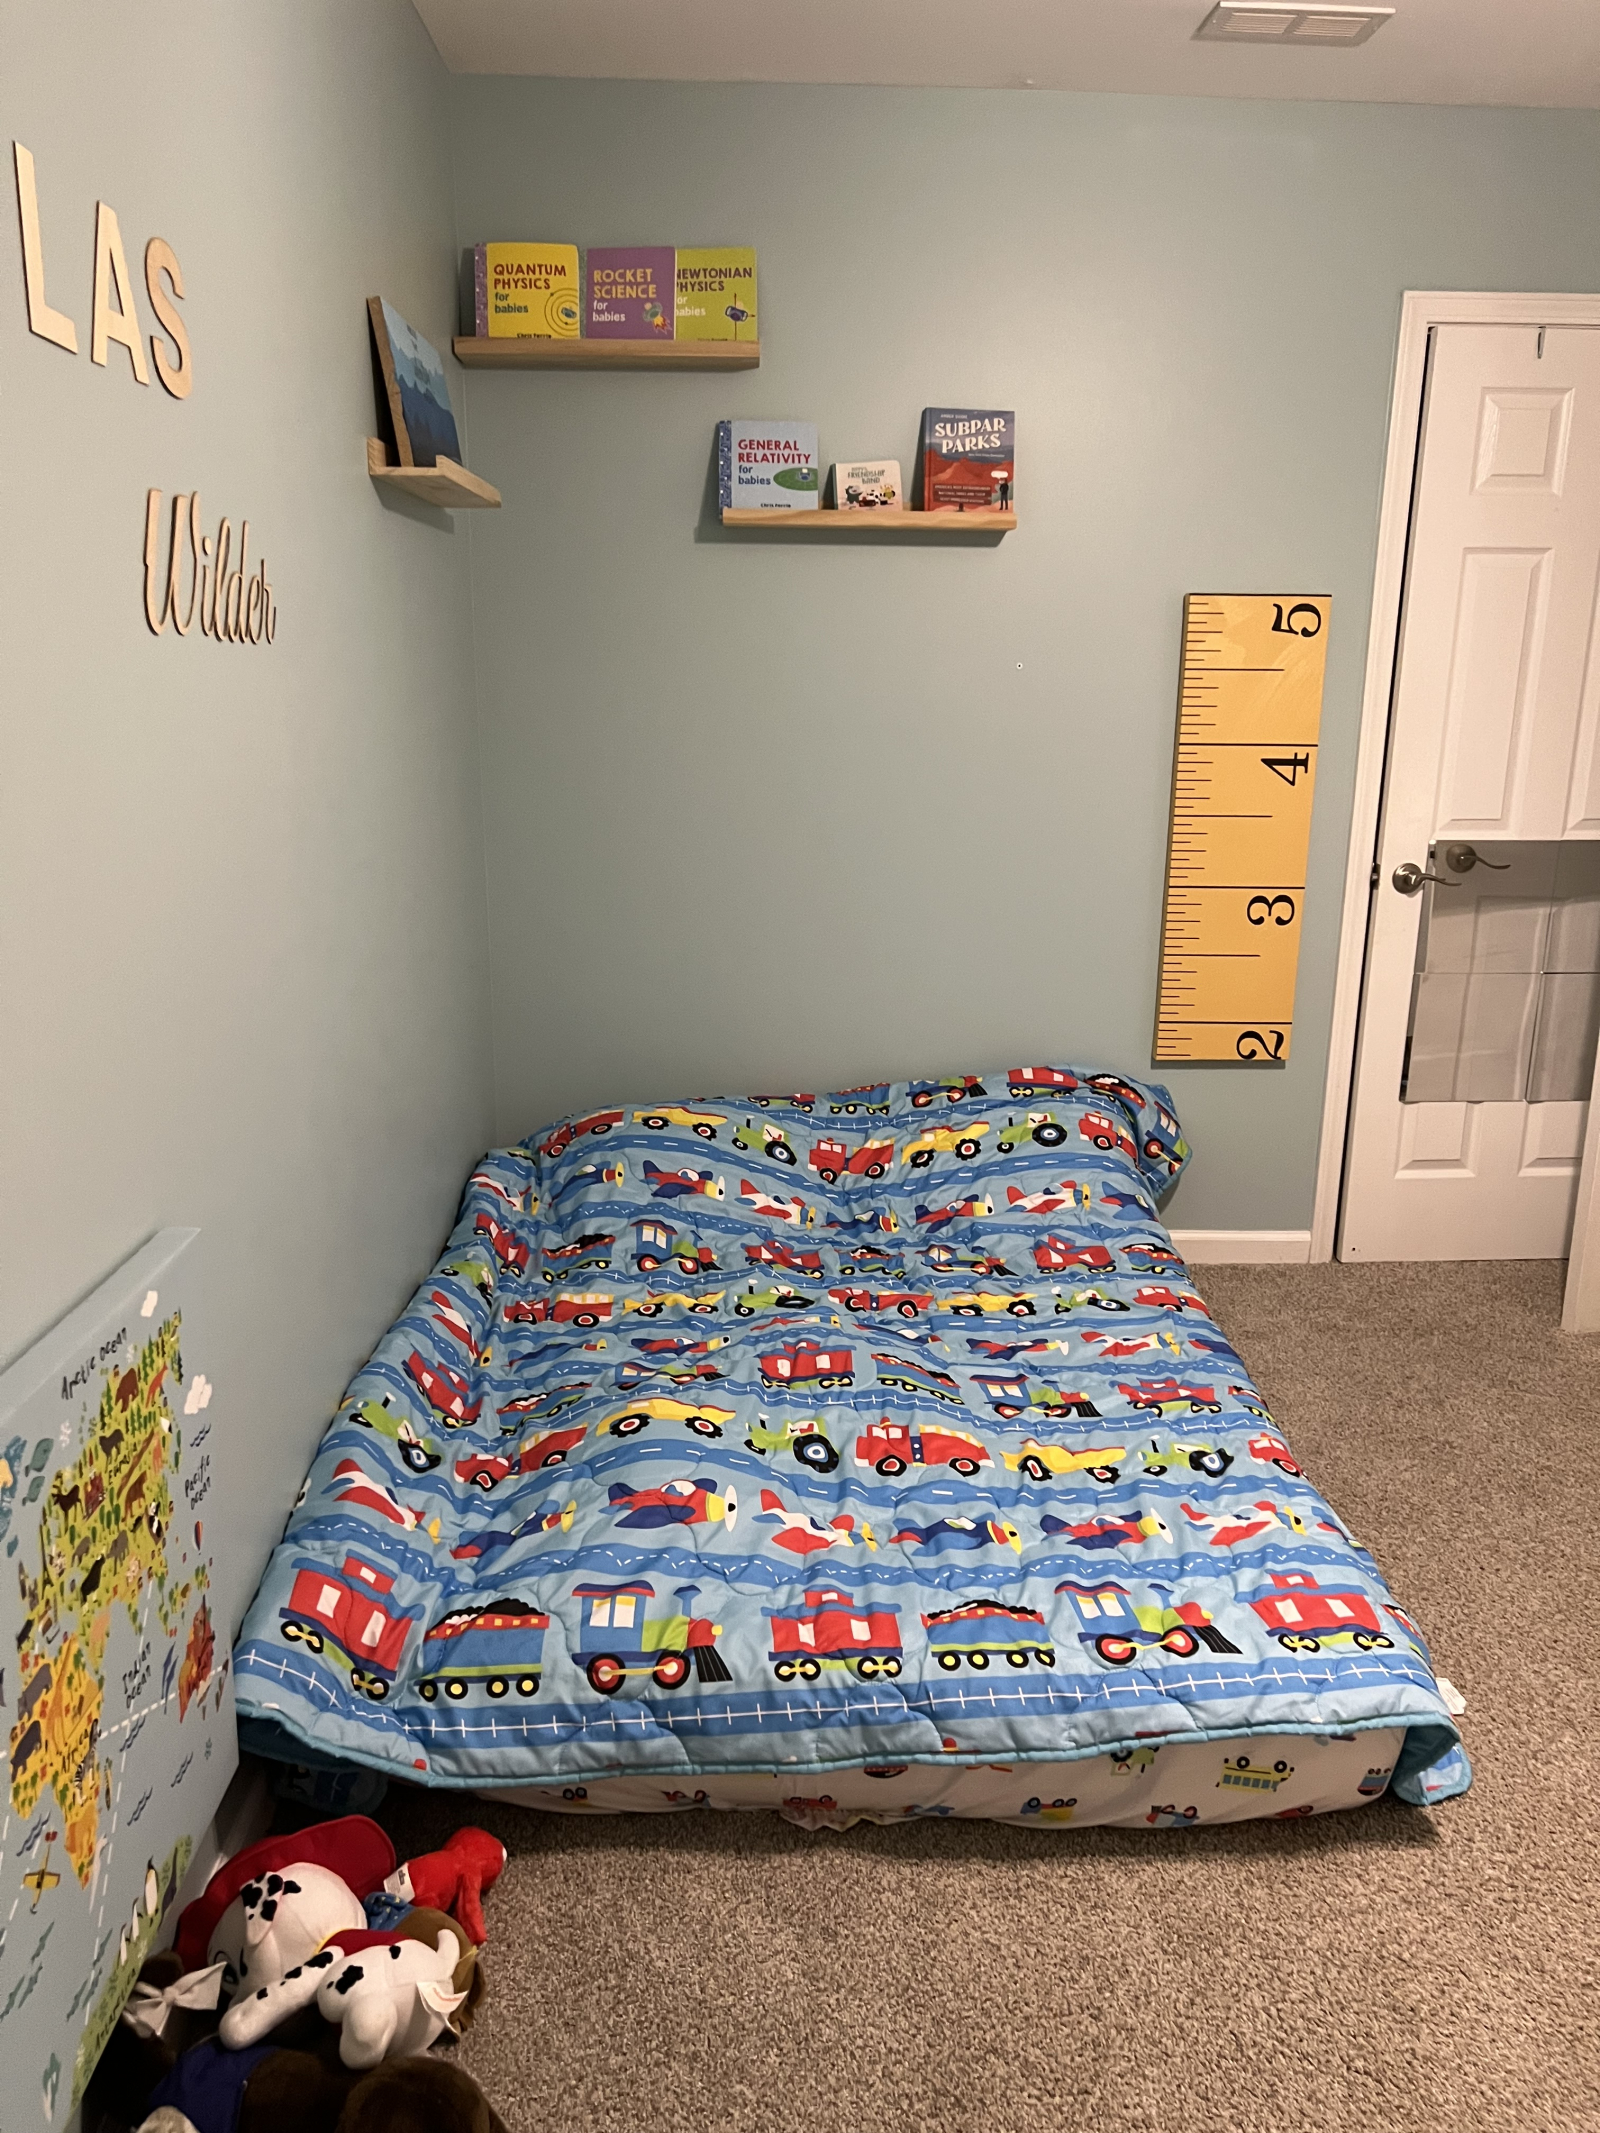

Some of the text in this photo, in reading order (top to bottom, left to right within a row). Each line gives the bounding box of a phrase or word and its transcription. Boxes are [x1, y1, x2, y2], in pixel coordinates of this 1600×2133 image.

[12, 140, 192, 400] LAS
[493, 263, 567, 277] QUANTUM
[593, 268, 653, 283] ROCKET
[493, 277, 551, 290] PHYSICS
[494, 292, 510, 302] for
[593, 284, 657, 299] SCIENCE
[494, 303, 529, 314] babies
[593, 299, 608, 310] for
[592, 311, 626, 322] babies
[935, 417, 1007, 438] SUBPAR
[738, 439, 799, 451] GENERAL
[941, 433, 1001, 454] PARKS
[738, 452, 811, 464] RELATIVITY
[738, 464, 753, 474] for
[738, 475, 771, 485] babies
[143, 488, 277, 645] Wilder
[1270, 602, 1322, 638] 5
[1260, 751, 1310, 787] 4
[1246, 893, 1296, 927] 3
[1235, 1029, 1286, 1061] 2
[61, 1356, 97, 1400] Arctic
[184, 1454, 211, 1497] Pacific
